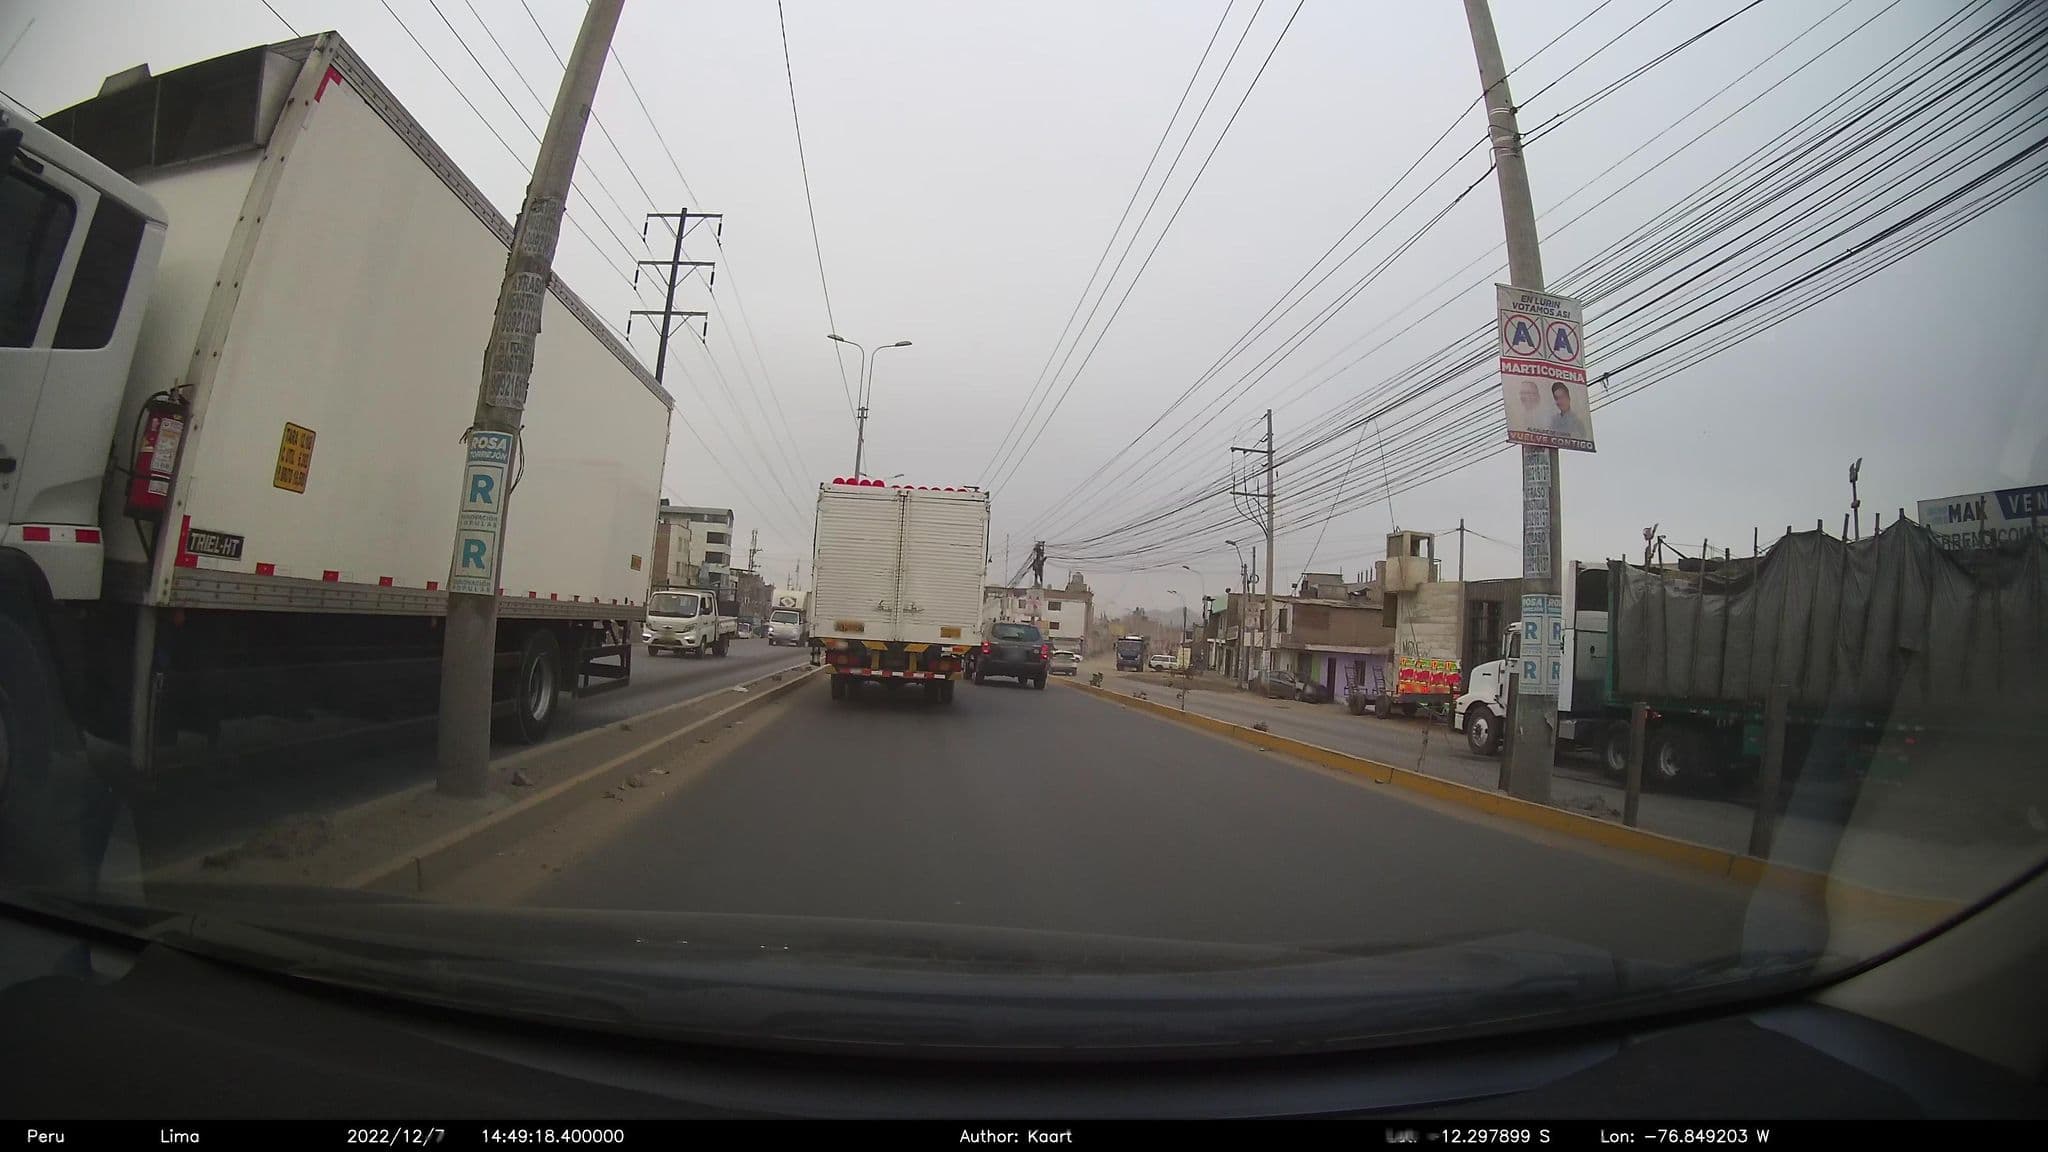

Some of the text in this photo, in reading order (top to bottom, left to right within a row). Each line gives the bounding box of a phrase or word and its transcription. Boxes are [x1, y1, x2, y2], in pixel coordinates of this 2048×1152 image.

[1513, 302, 1555, 317] VOTAMOS
[1521, 295, 1534, 304] EN
[1513, 321, 1535, 348] A
[1554, 328, 1574, 355] A
[1501, 361, 1586, 383] MARTICORENA
[470, 436, 508, 451] ROSA
[1509, 430, 1593, 450] VUELVE CONTIGO
[470, 474, 495, 505] R
[1948, 501, 1988, 523] MAK
[461, 538, 487, 570] R
[1525, 621, 1538, 640] R
[1524, 660, 1537, 680] R
